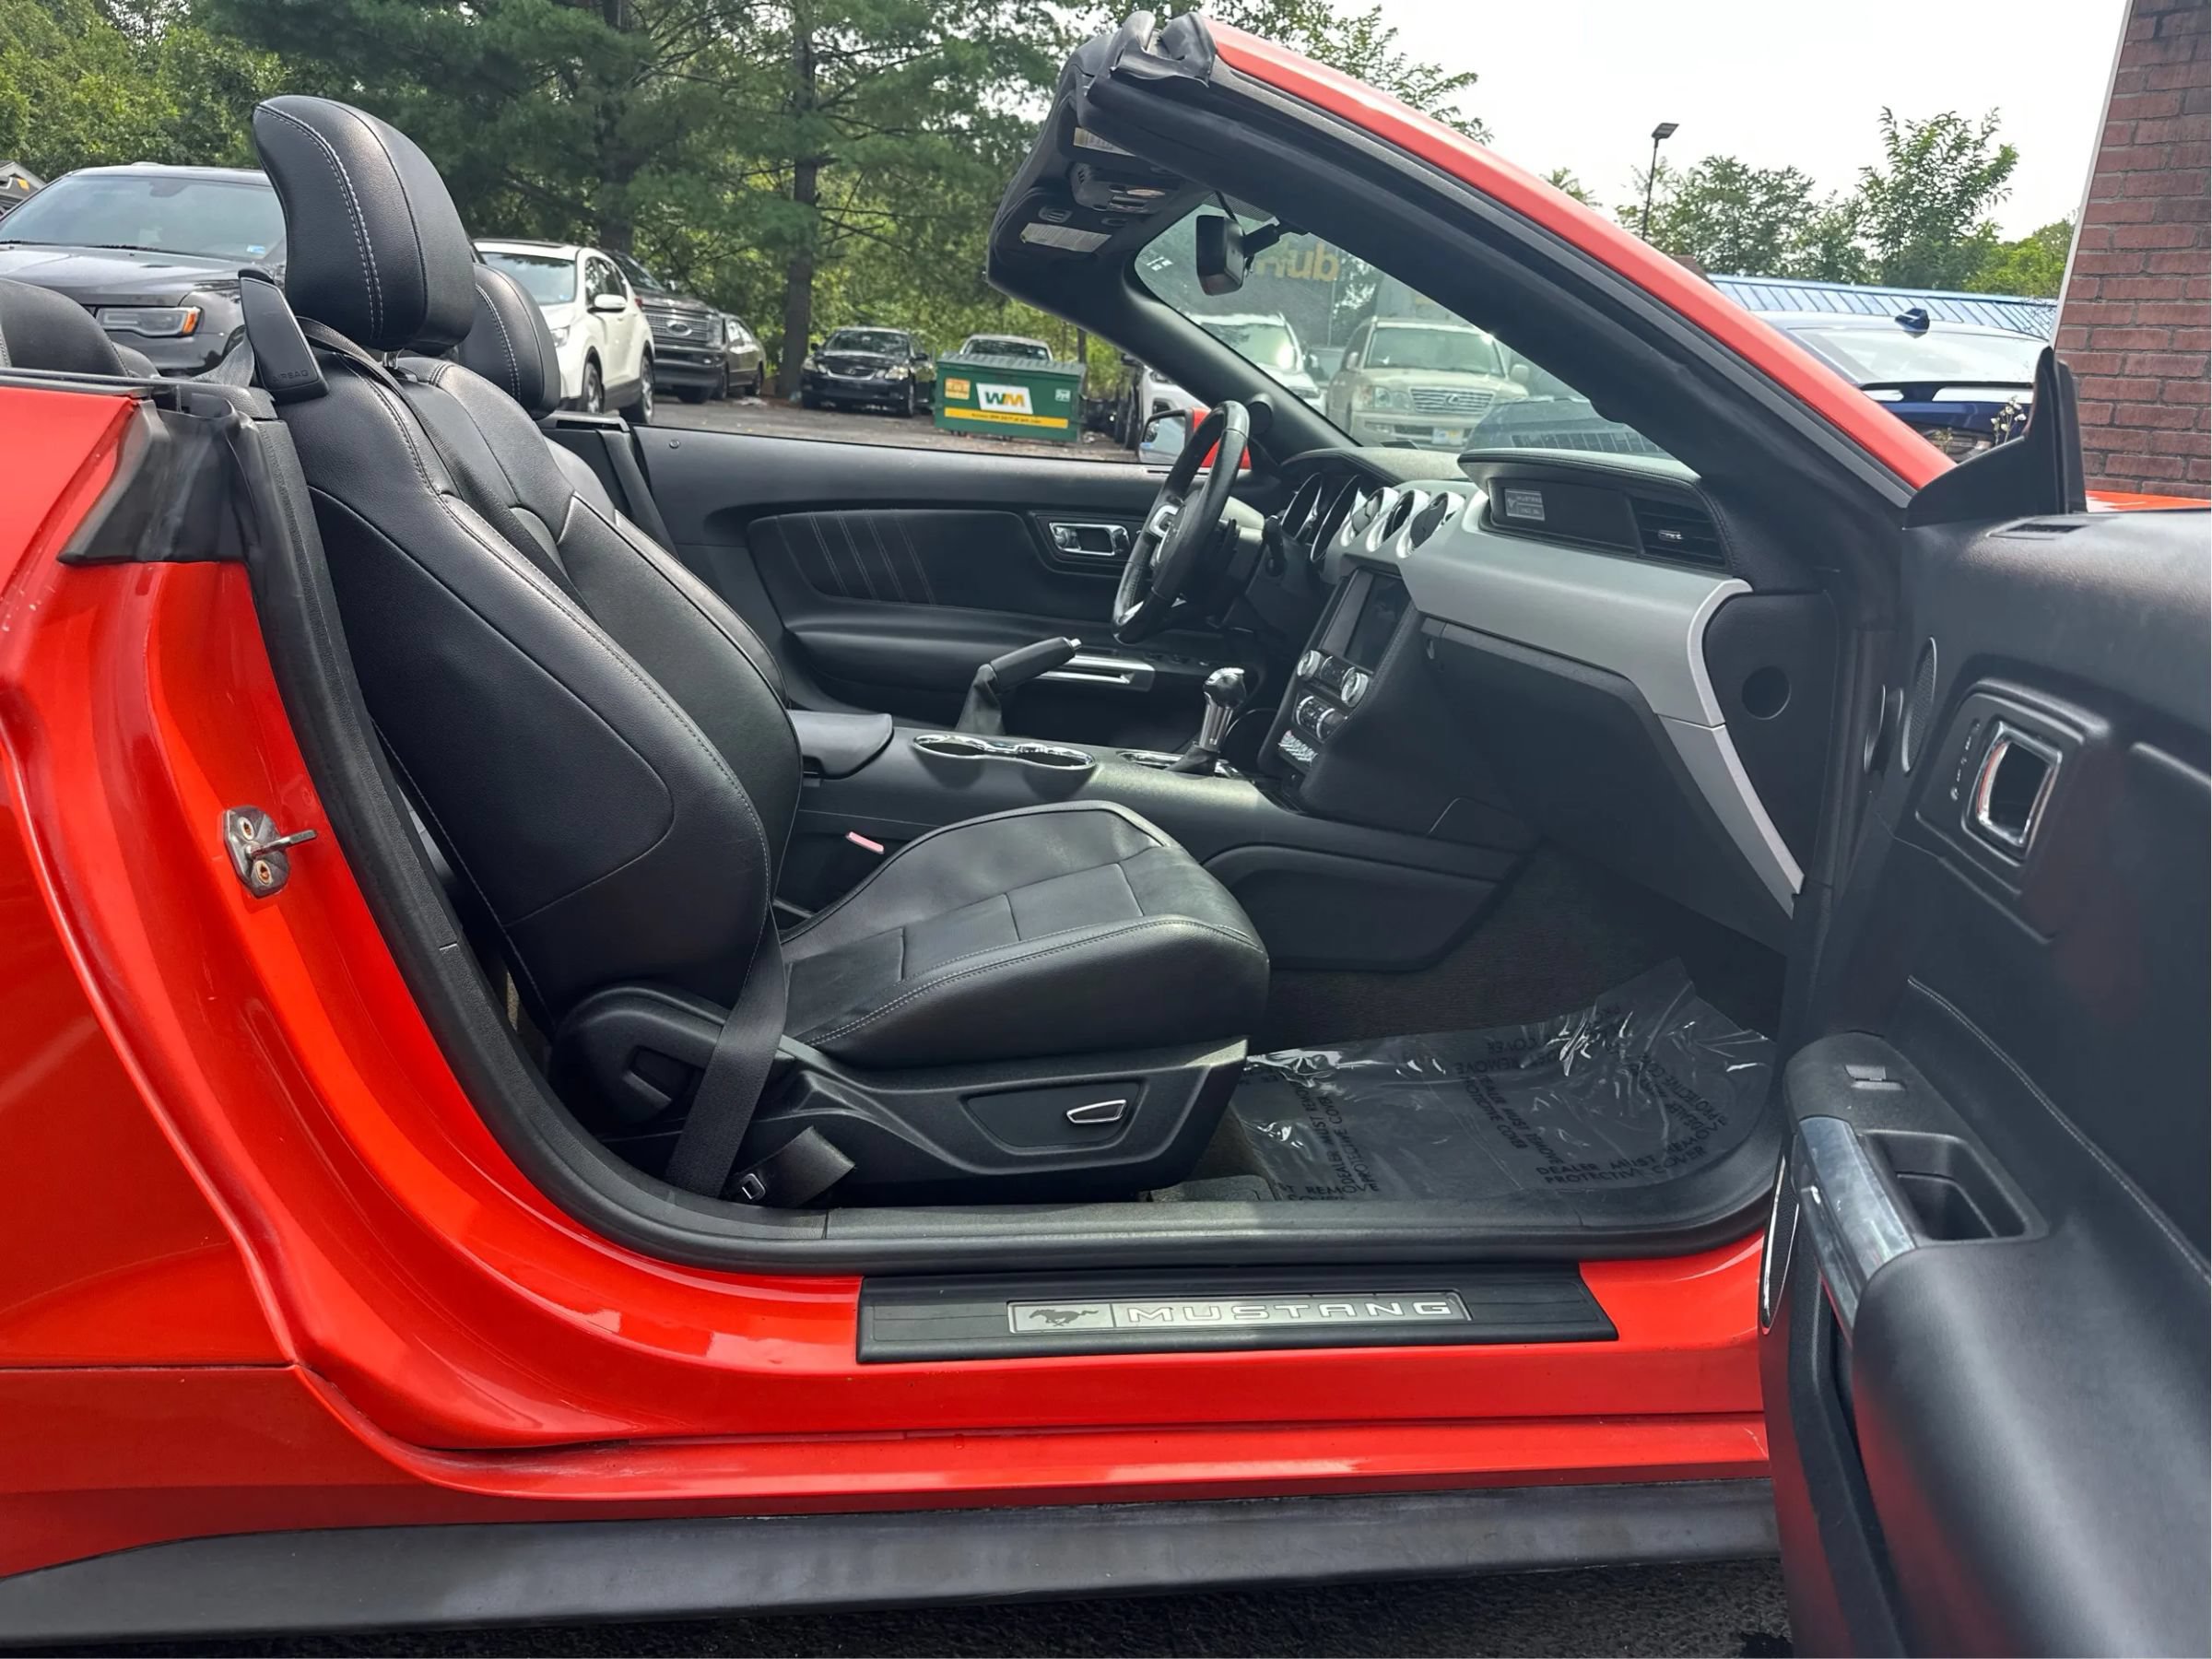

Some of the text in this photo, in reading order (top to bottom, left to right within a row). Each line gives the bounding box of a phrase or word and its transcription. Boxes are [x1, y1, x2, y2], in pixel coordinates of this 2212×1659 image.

[272, 369, 310, 383] AIRBAG
[984, 391, 1025, 407] WM
[1317, 1095, 1343, 1124] COVER
[1309, 1114, 1335, 1146] MUST
[1326, 1150, 1356, 1185] DEALER
[1536, 1163, 1600, 1176] DEALER
[1609, 1154, 1656, 1170] MUST
[1651, 1146, 1706, 1173] COVER
[1305, 1183, 1380, 1195] REMOVE
[1127, 1301, 1453, 1323] MUSTANG
